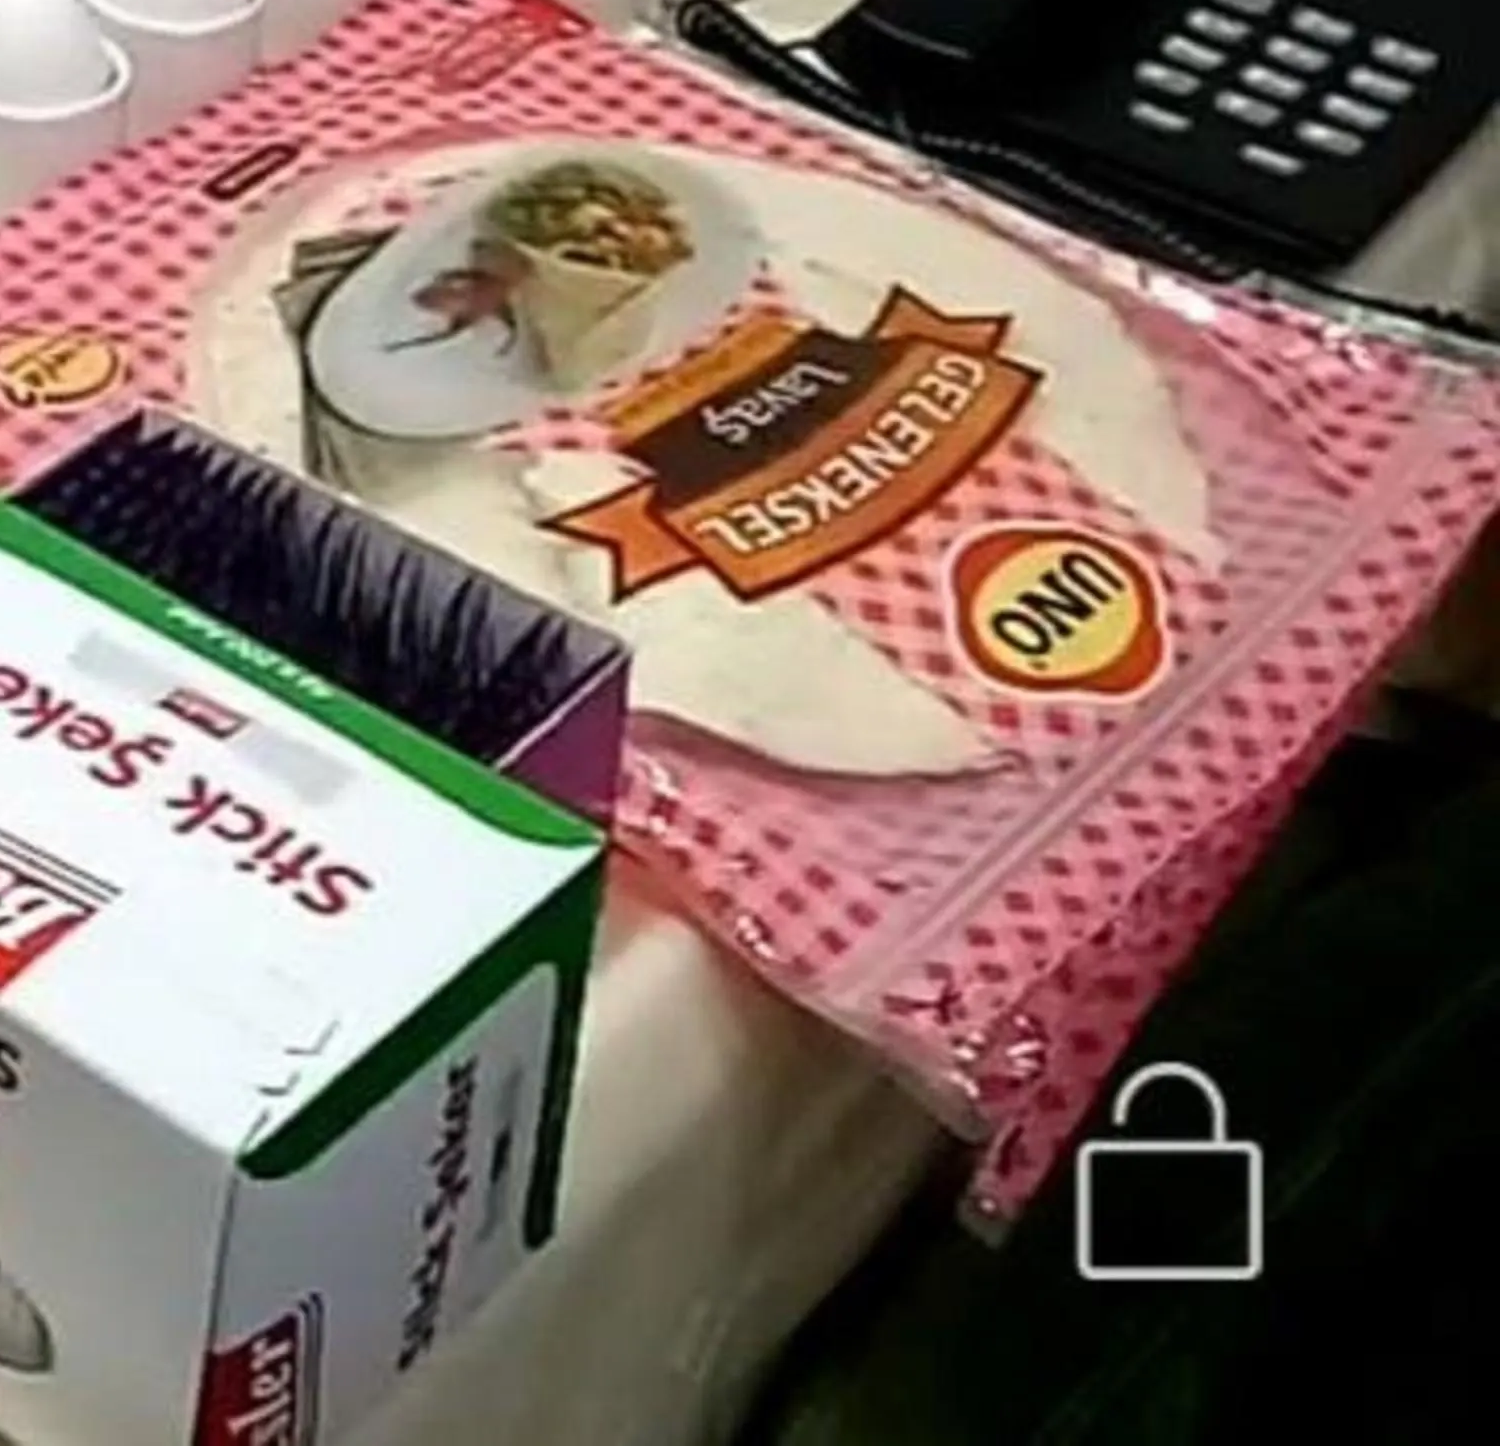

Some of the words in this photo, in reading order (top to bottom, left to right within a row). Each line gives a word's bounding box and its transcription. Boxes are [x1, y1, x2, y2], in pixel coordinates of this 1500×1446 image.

[695, 351, 987, 553] GELENEKSEL
[990, 550, 1126, 657] UNO
[167, 774, 375, 917] Stick
